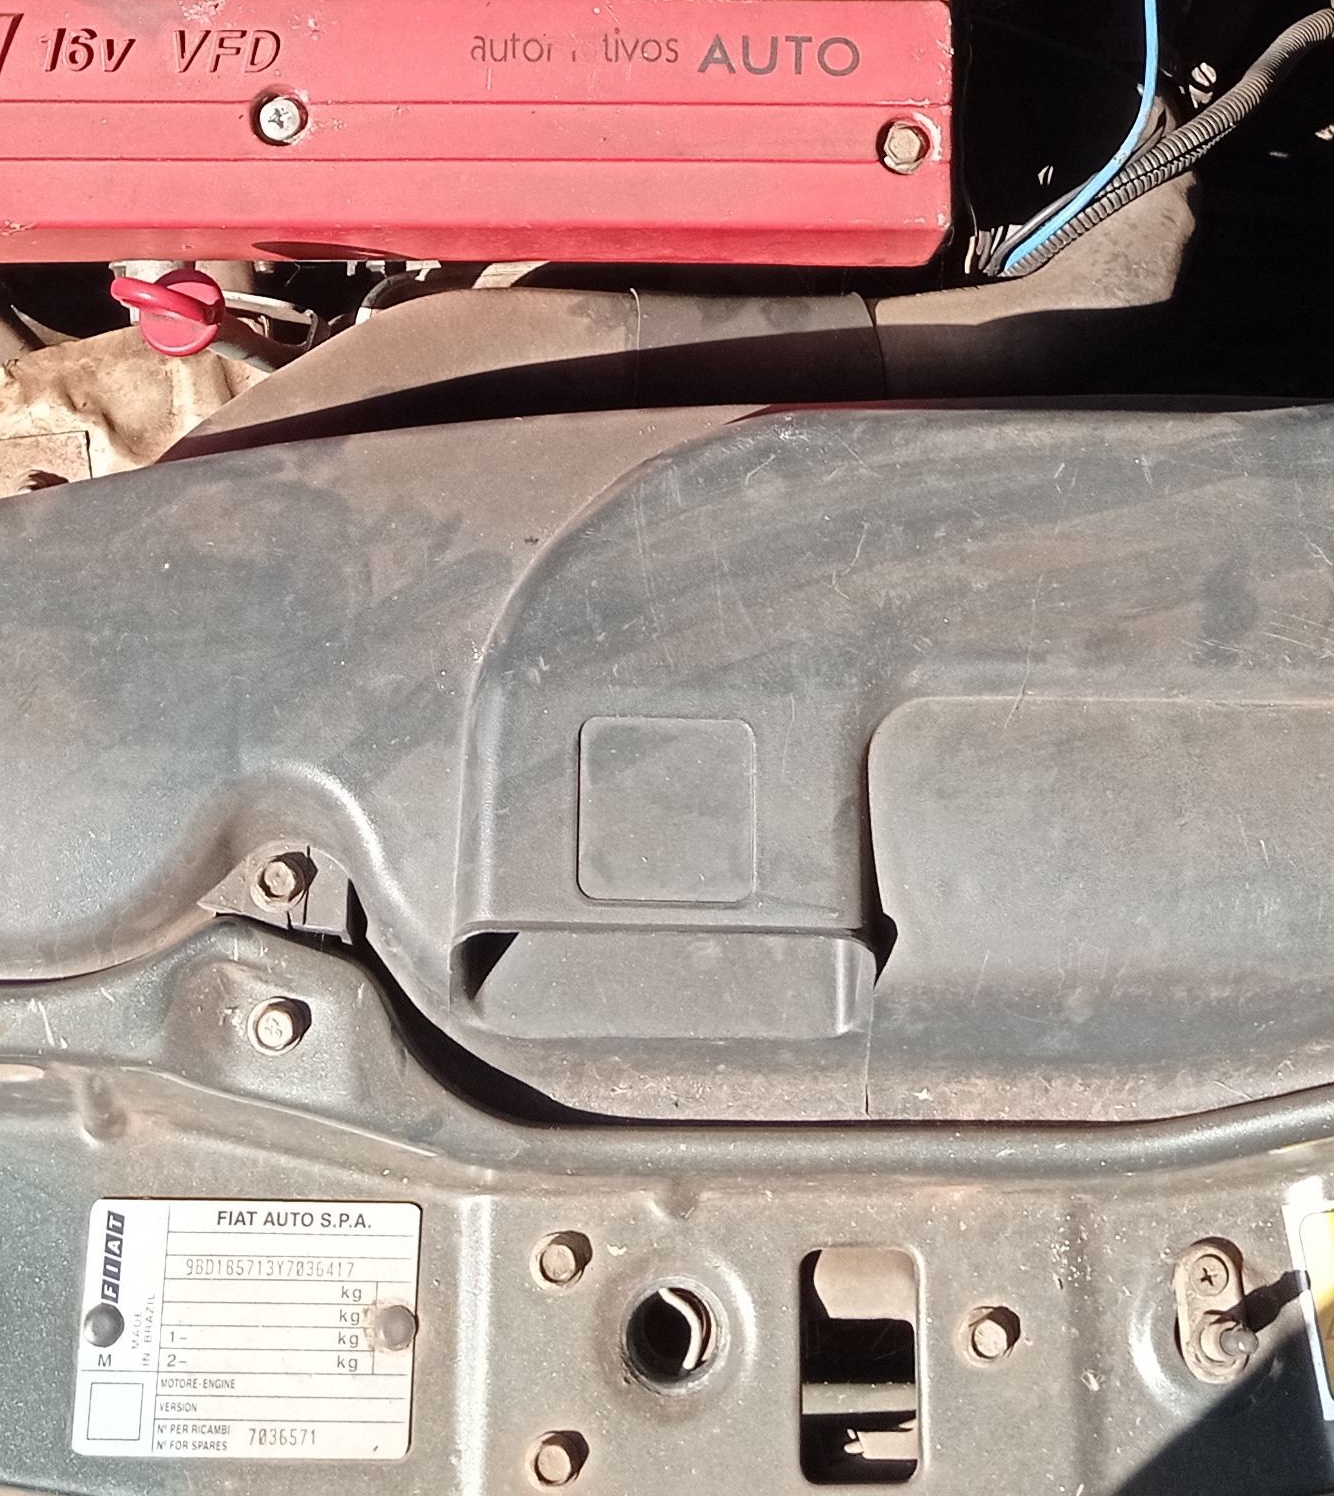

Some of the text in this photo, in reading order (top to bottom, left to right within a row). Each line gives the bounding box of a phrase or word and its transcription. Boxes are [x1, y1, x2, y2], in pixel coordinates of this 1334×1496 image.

[175, 28, 281, 73] VFD
[470, 27, 861, 77] autotivos AUTO
[217, 1210, 373, 1229] FIAT AUTO S.P.A.
[102, 1210, 125, 1303] FIAT
[341, 1285, 362, 1302] kg
[339, 1309, 360, 1326] kg
[338, 1332, 359, 1348] kg
[98, 1355, 112, 1367] M
[336, 1356, 358, 1372] kg
[160, 1403, 197, 1412] VERSION
[170, 1424, 188, 1434] PER
[192, 1424, 230, 1435] RICAMBI
[249, 1428, 316, 1446] 7036571
[170, 1441, 188, 1450] FOR
[192, 1441, 227, 1450] SPARES
